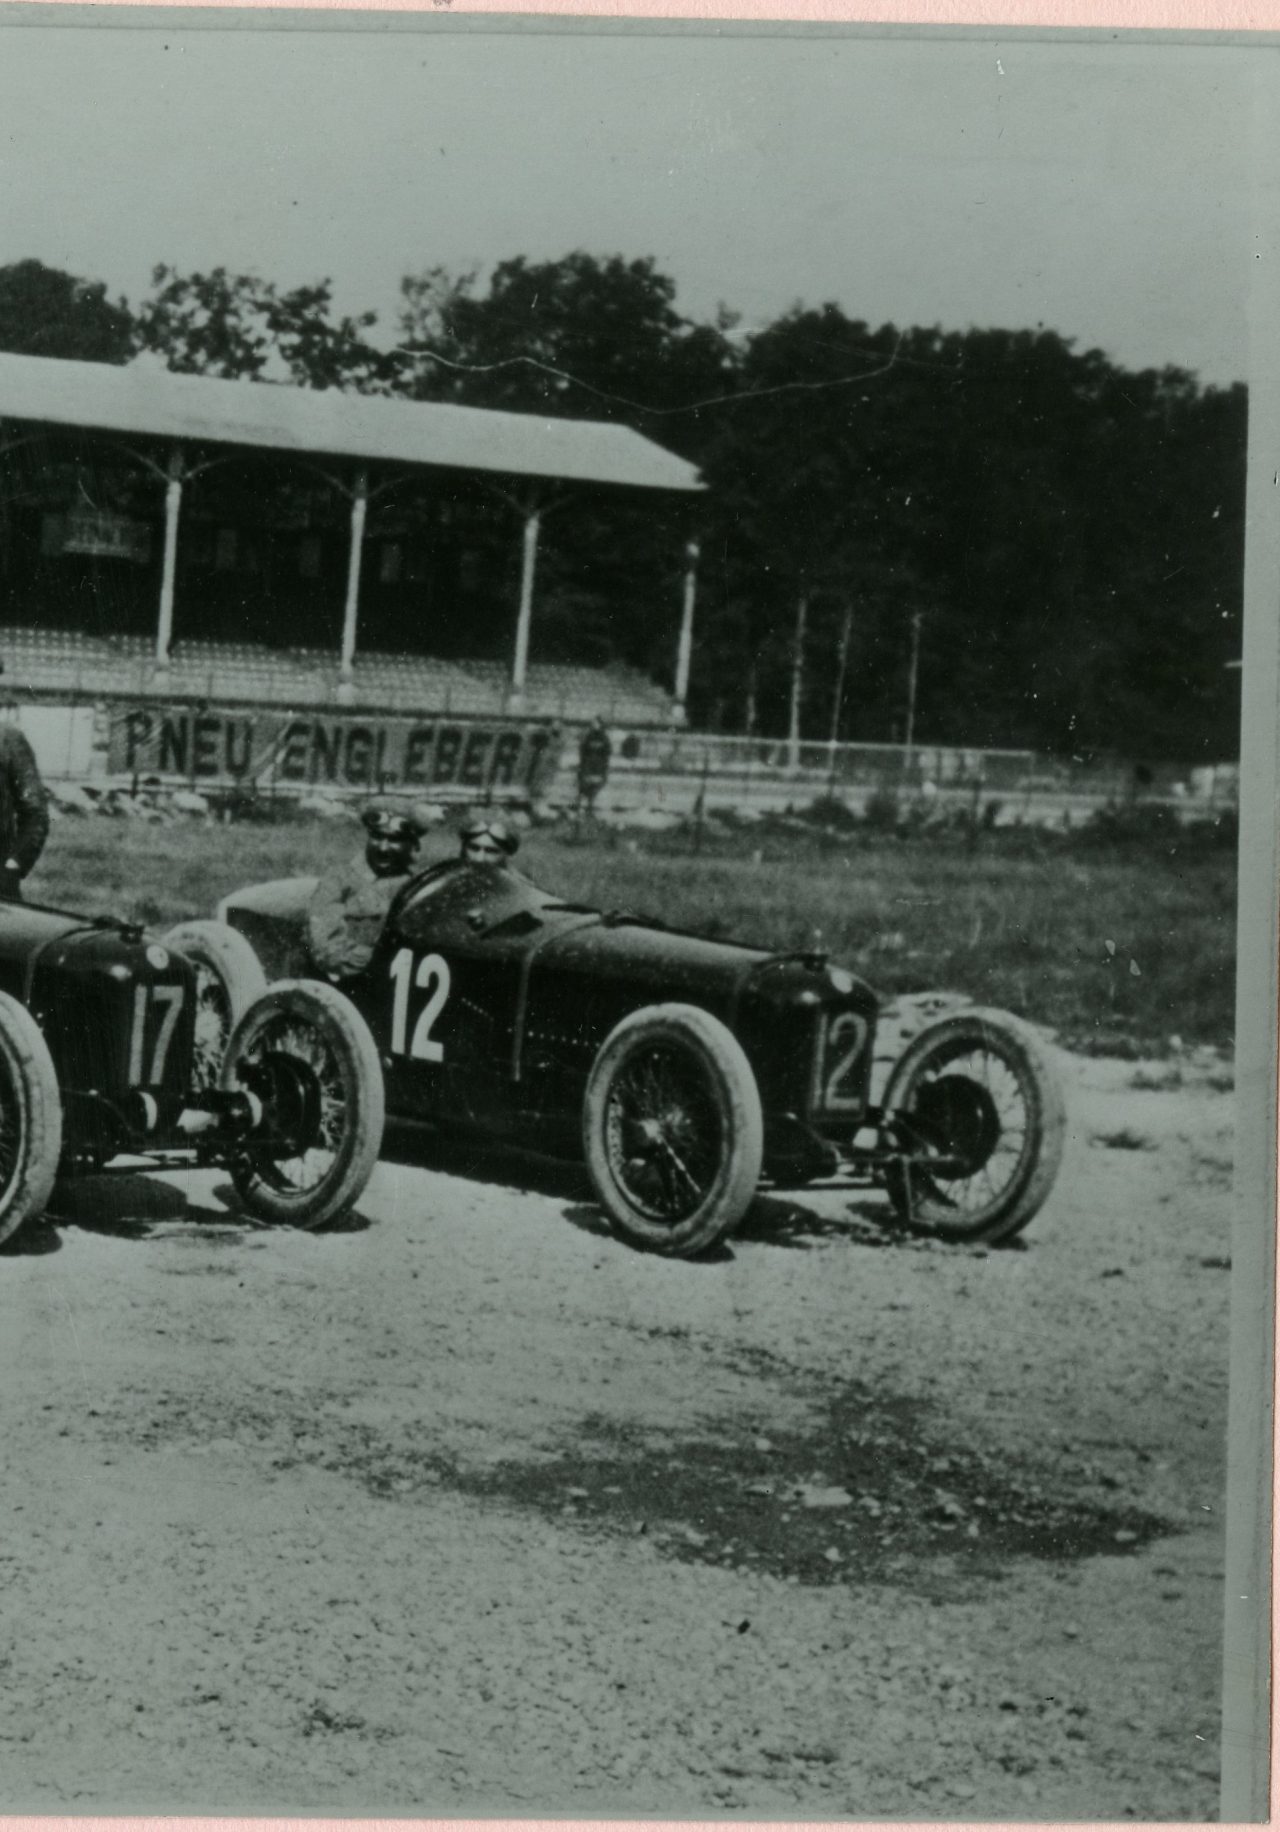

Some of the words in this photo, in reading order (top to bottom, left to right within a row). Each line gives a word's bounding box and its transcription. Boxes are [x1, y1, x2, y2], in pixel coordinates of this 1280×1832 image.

[125, 711, 253, 777] PNEU
[281, 721, 551, 787] ENGLEBERT
[128, 984, 185, 1086] 17
[389, 947, 450, 1062] 12
[810, 1011, 868, 1110] 12
